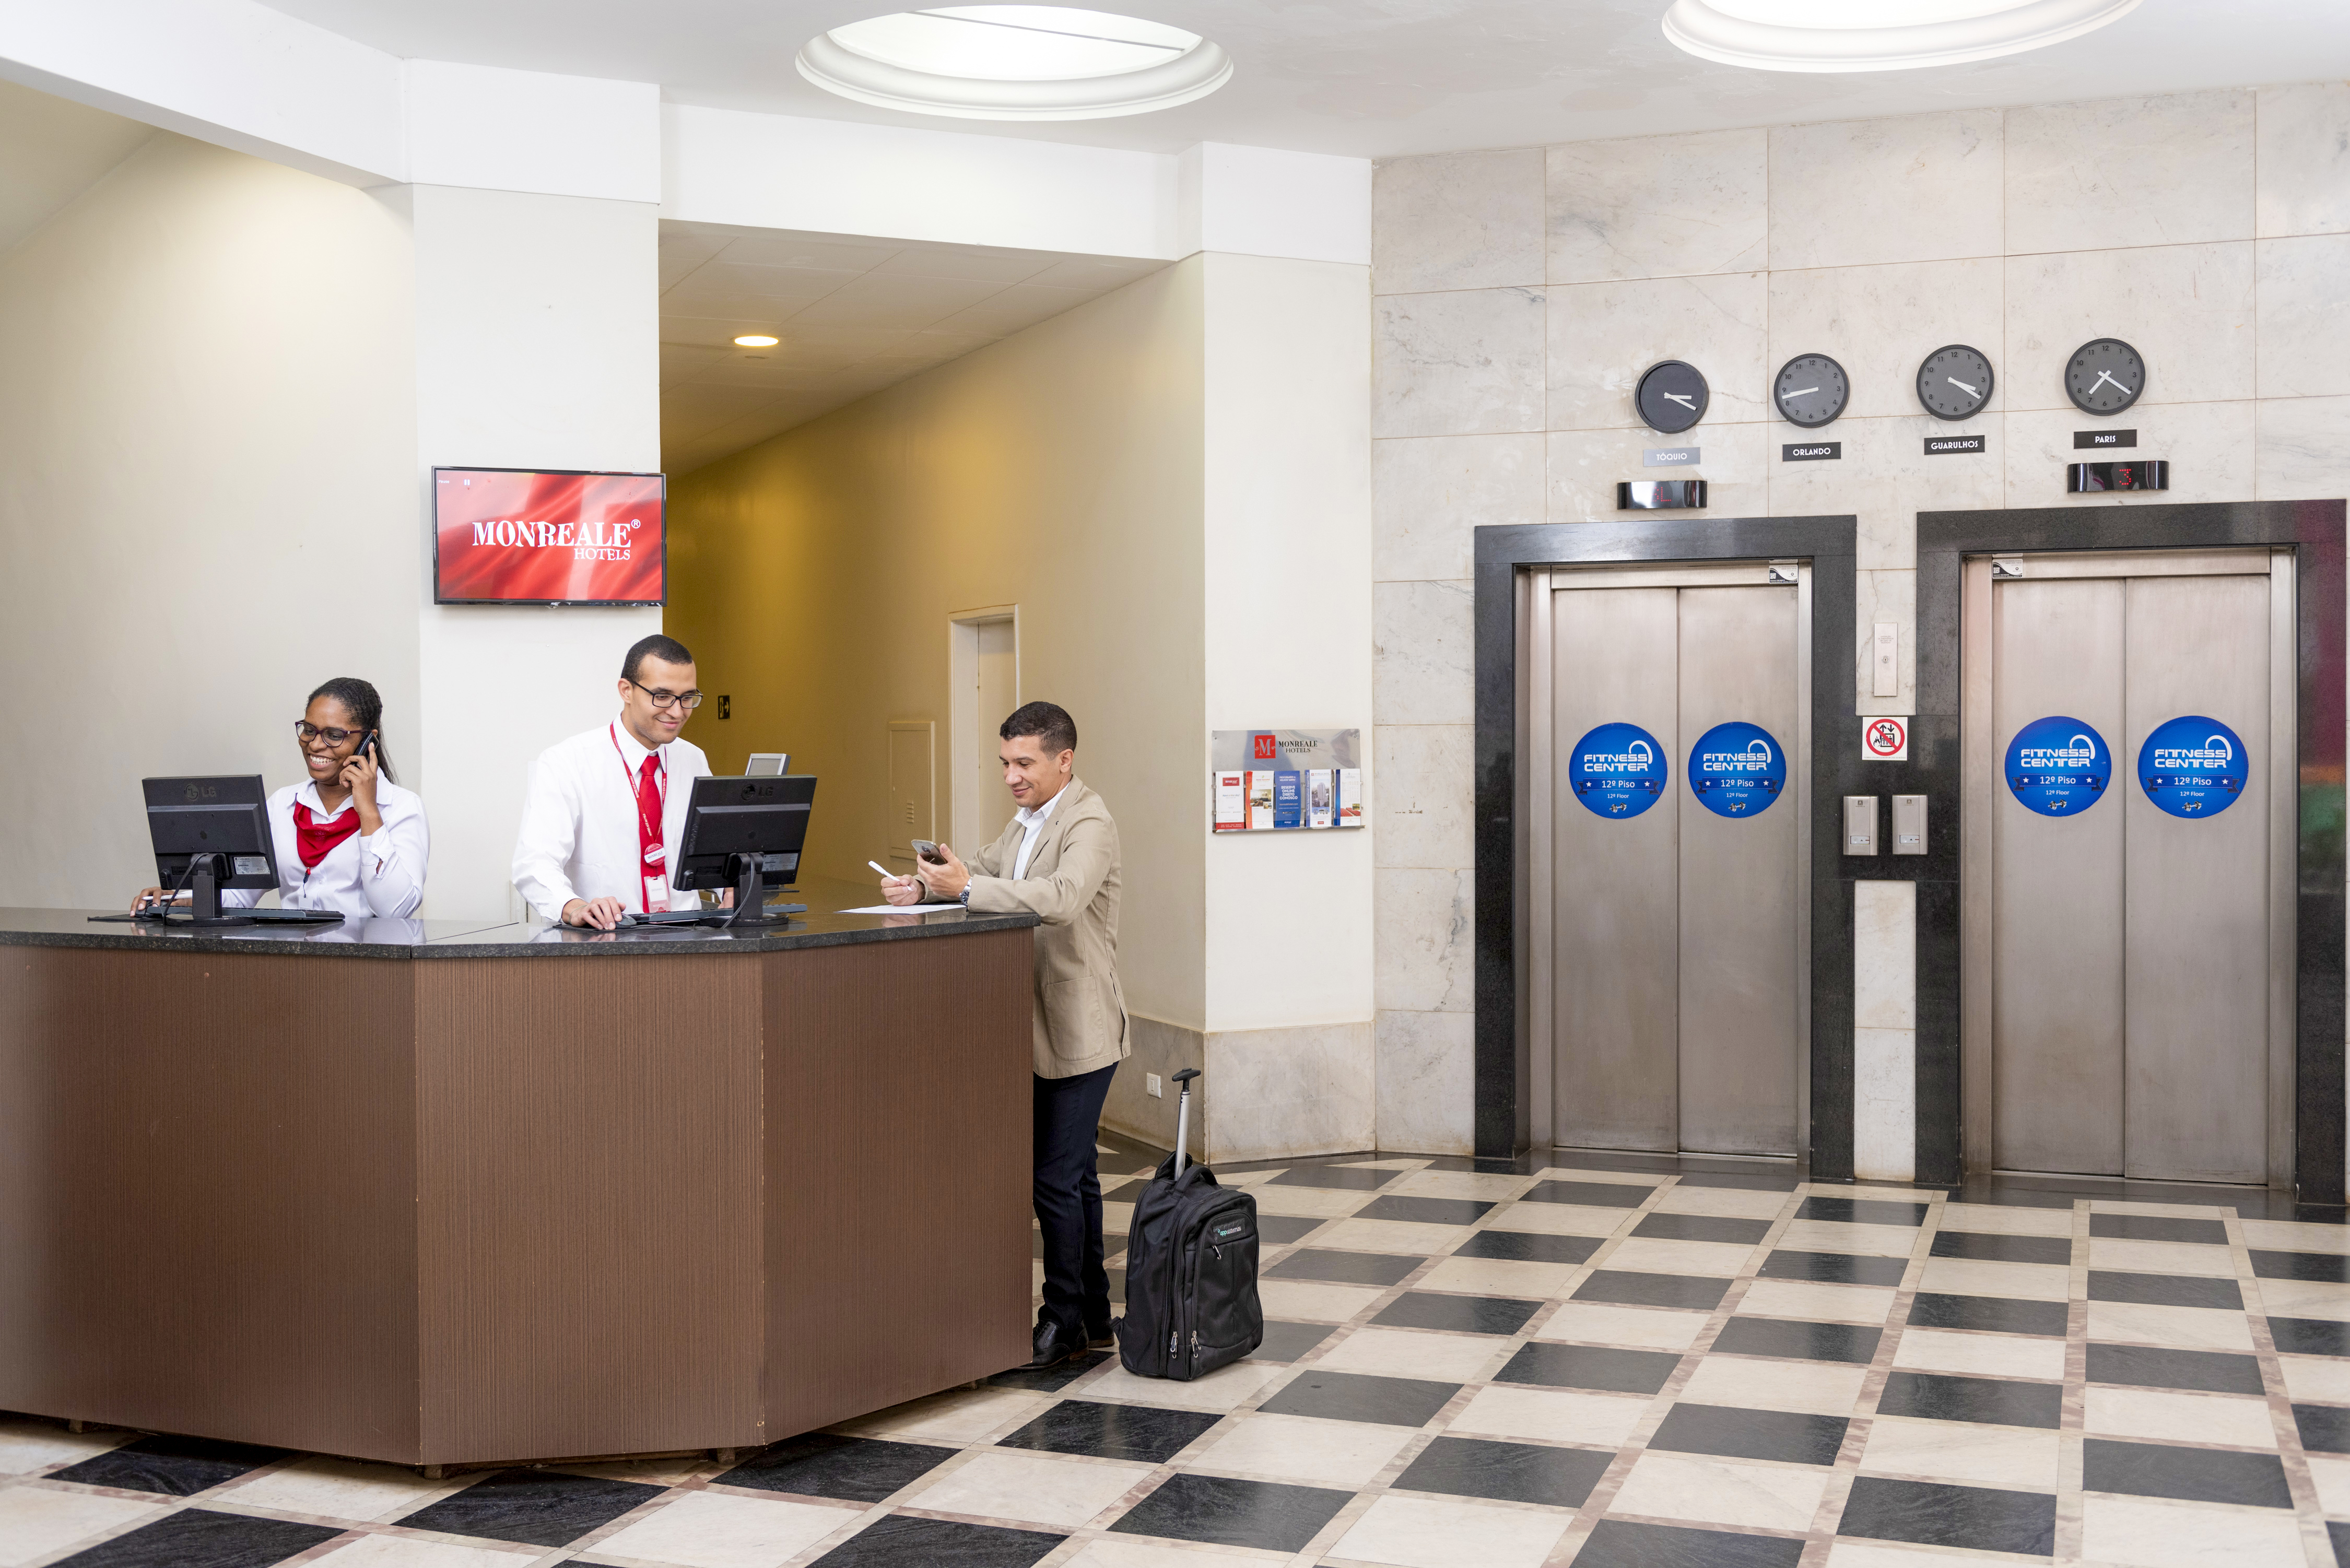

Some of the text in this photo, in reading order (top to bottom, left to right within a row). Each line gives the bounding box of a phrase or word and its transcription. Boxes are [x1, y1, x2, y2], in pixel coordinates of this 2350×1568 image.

[2095, 435, 2116, 443] PARIS
[1931, 441, 1978, 450] GUARULHOS
[1793, 447, 1831, 456] ORLANDO
[1656, 452, 1687, 461] TÓQUIO
[2119, 468, 2132, 486] 3
[574, 548, 630, 561] HOTELS
[1259, 739, 1271, 756] M
[1703, 753, 1766, 761] FITNESS
[2021, 749, 2089, 758] FITNESS
[2155, 749, 2226, 758] FITNESS
[1703, 762, 1767, 771] CENTER
[2021, 758, 2090, 767] CENTER
[2155, 759, 2227, 768] CENTER
[1584, 763, 1648, 772] CENTER
[1618, 780, 1635, 788] Piso
[1737, 779, 1754, 787] Piso
[2040, 776, 2076, 784] 12º Piso
[2174, 776, 2212, 785] 12º Piso
[201, 786, 216, 798] LG
[758, 786, 773, 797] LG
